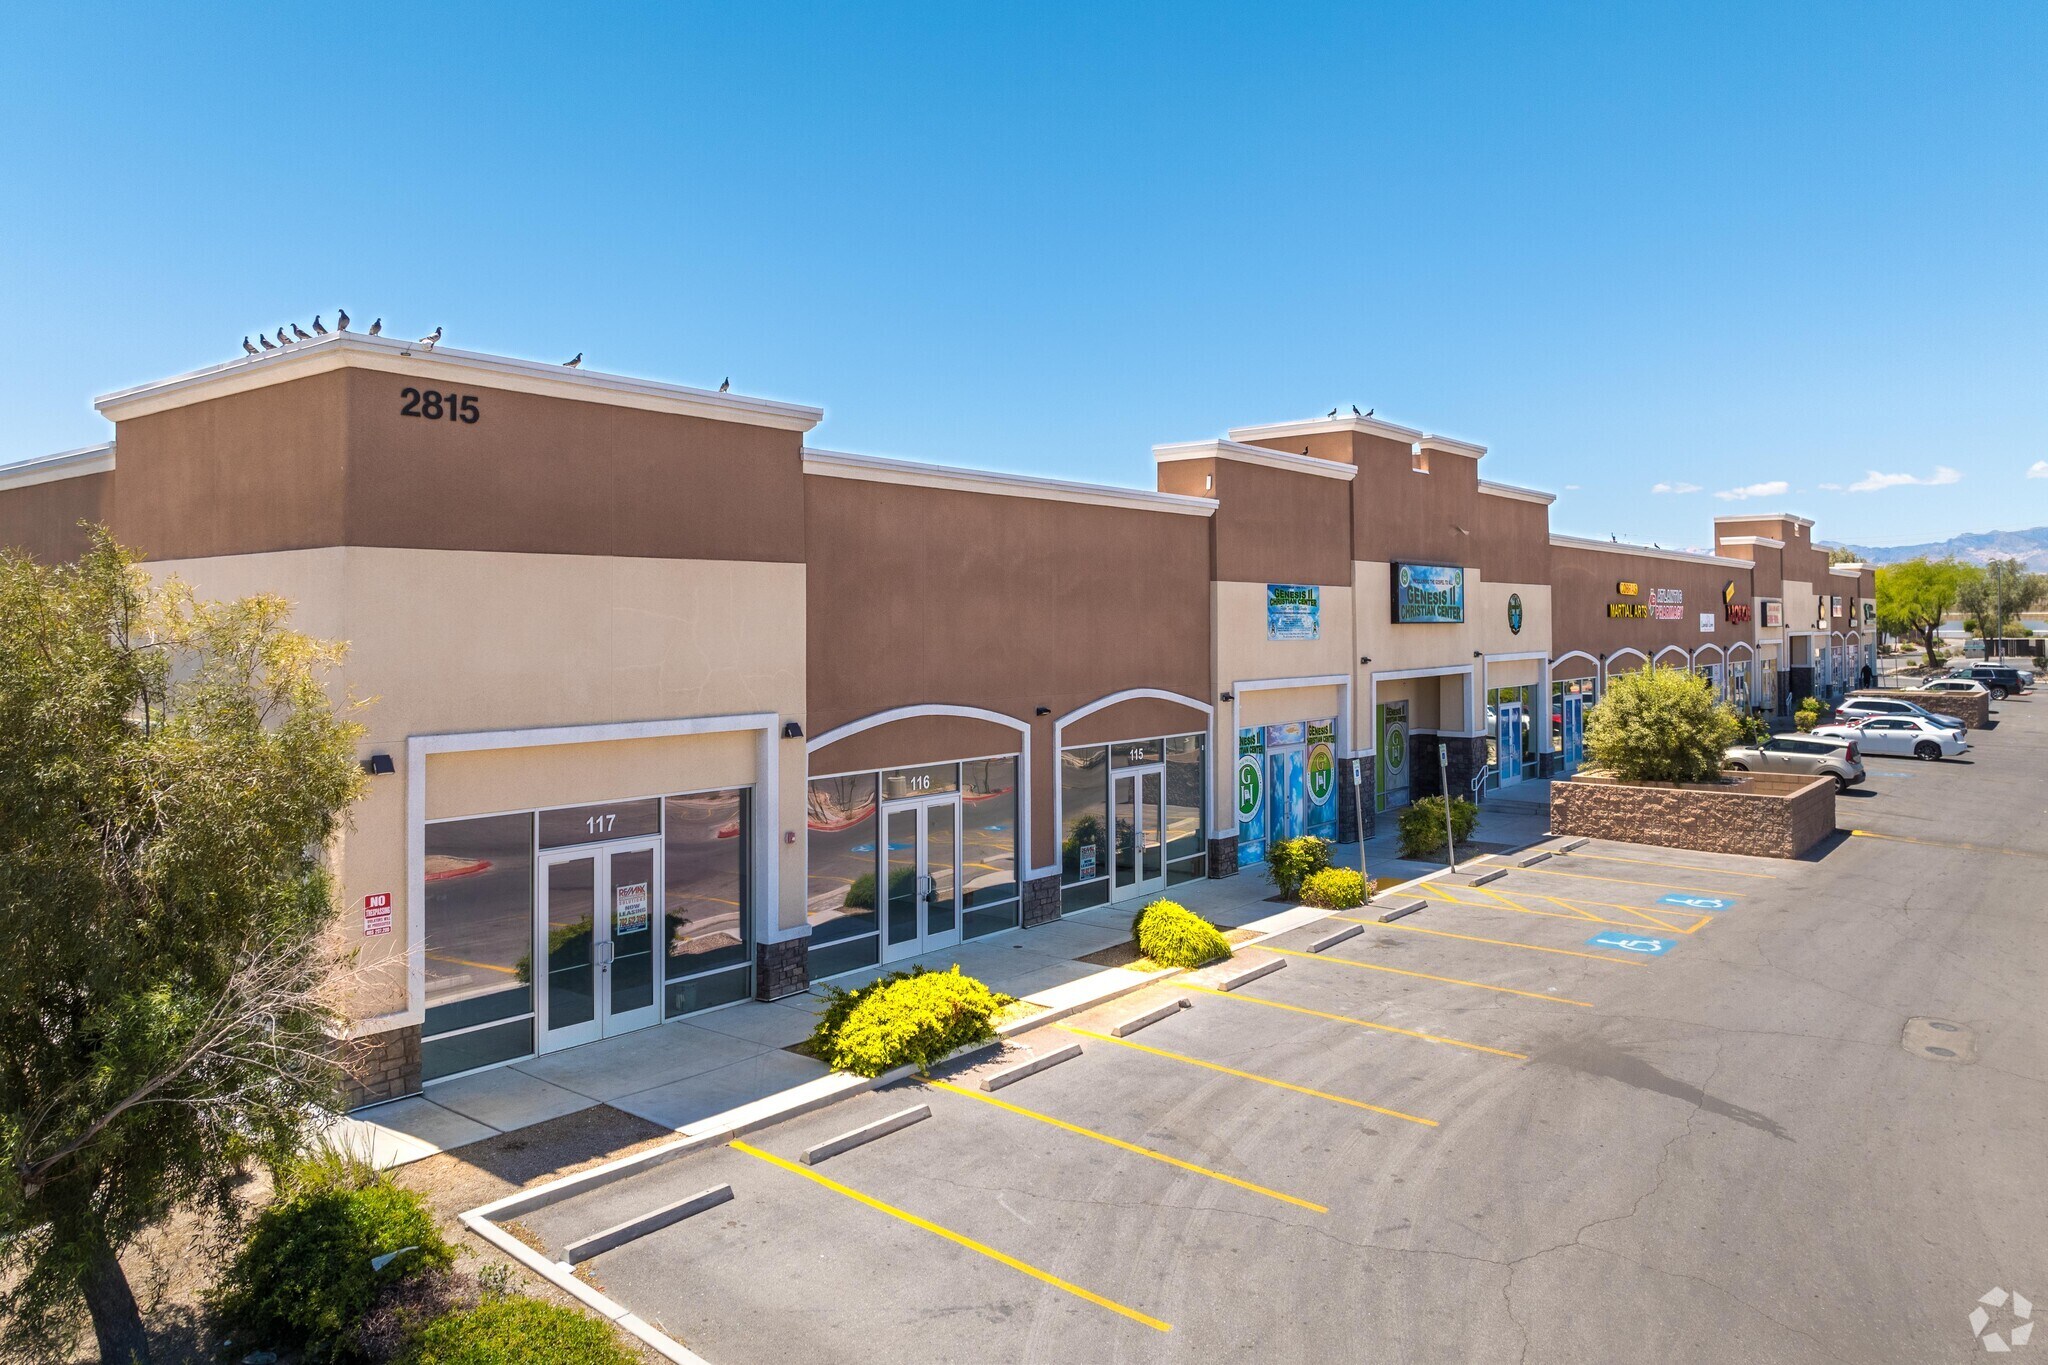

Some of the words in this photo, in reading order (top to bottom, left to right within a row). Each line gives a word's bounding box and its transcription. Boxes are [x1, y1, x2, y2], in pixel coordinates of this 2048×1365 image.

[401, 387, 479, 424] 2815
[1274, 588, 1306, 599] GENESIS
[1407, 585, 1448, 605] GENESIS
[1450, 585, 1456, 605] II
[1657, 588, 1683, 603] ATLANTIC
[1270, 598, 1297, 606] CHRISTIAN
[1298, 598, 1317, 607] CENTER
[1401, 604, 1436, 619] CHRISTIAN
[1436, 605, 1461, 620] CENTER
[1609, 603, 1633, 618] MARTIAL
[1634, 604, 1647, 618] ARTS
[1655, 605, 1684, 619] PHARMACY
[1308, 724, 1328, 736] GENESIS
[1239, 735, 1256, 746] NESIS
[1323, 735, 1335, 743] CENTER
[1130, 748, 1144, 761] 115
[1250, 745, 1264, 754] CENTER
[1316, 755, 1324, 770] G
[910, 775, 930, 790] 116
[1241, 767, 1252, 785] G
[586, 814, 616, 834] 117
[619, 885, 646, 896] RE/MAX
[370, 895, 386, 907] NO
[366, 907, 391, 916] TRESPASSING
[619, 907, 646, 917] LEASING
